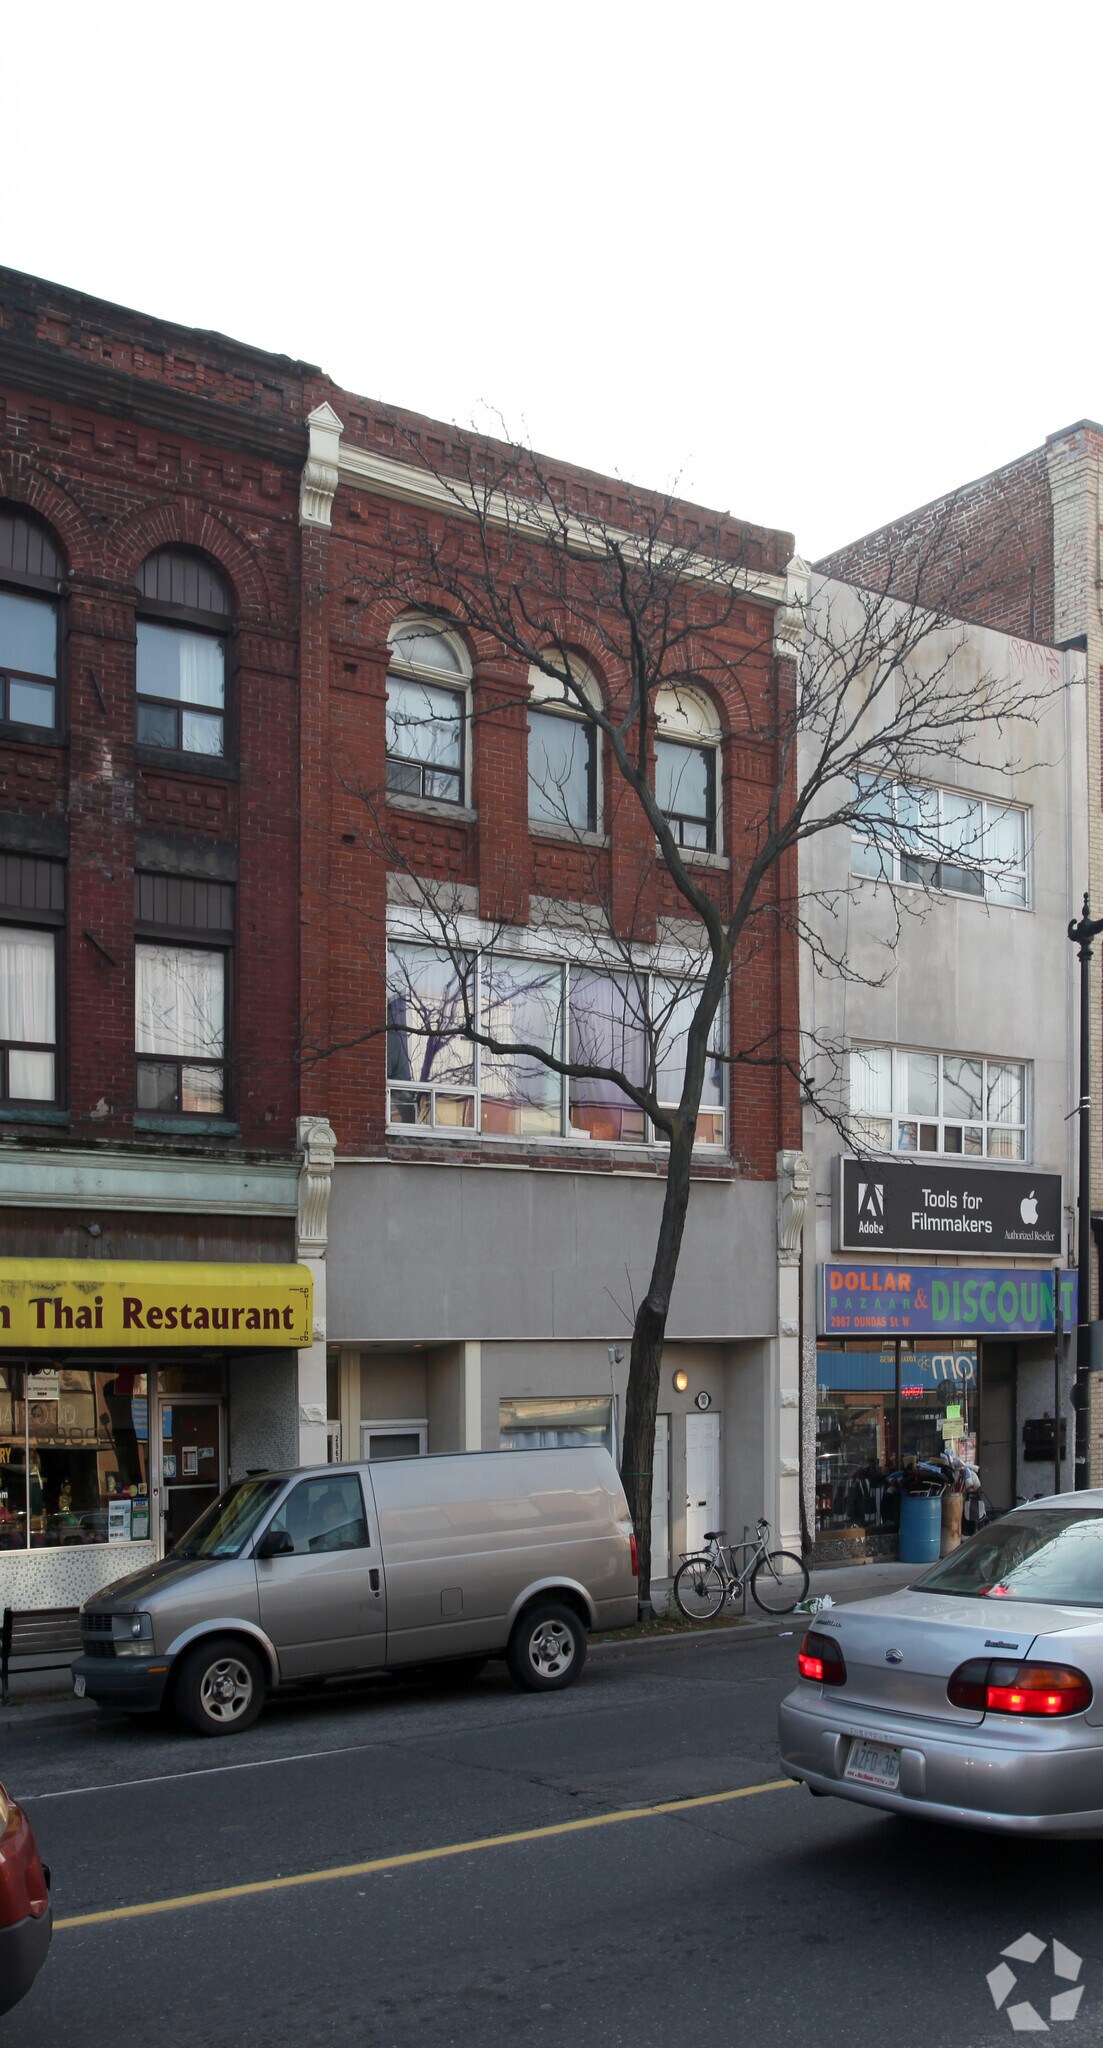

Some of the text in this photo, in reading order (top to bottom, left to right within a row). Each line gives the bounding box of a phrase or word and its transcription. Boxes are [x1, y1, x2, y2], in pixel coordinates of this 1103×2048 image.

[922, 1189, 983, 1210] Tools for
[858, 1220, 884, 1234] Adobe
[911, 1211, 993, 1234] Filmmakers
[1004, 1229, 1056, 1242] Authorized Reseller
[830, 1271, 912, 1292] DOLLAR
[830, 1296, 911, 1310] BAZAAR
[914, 1279, 1074, 1324] & DISCOUNT
[28, 1295, 104, 1329] Thai
[122, 1296, 295, 1330] Restaurant
[854, 1316, 887, 1328] DUNDAS
